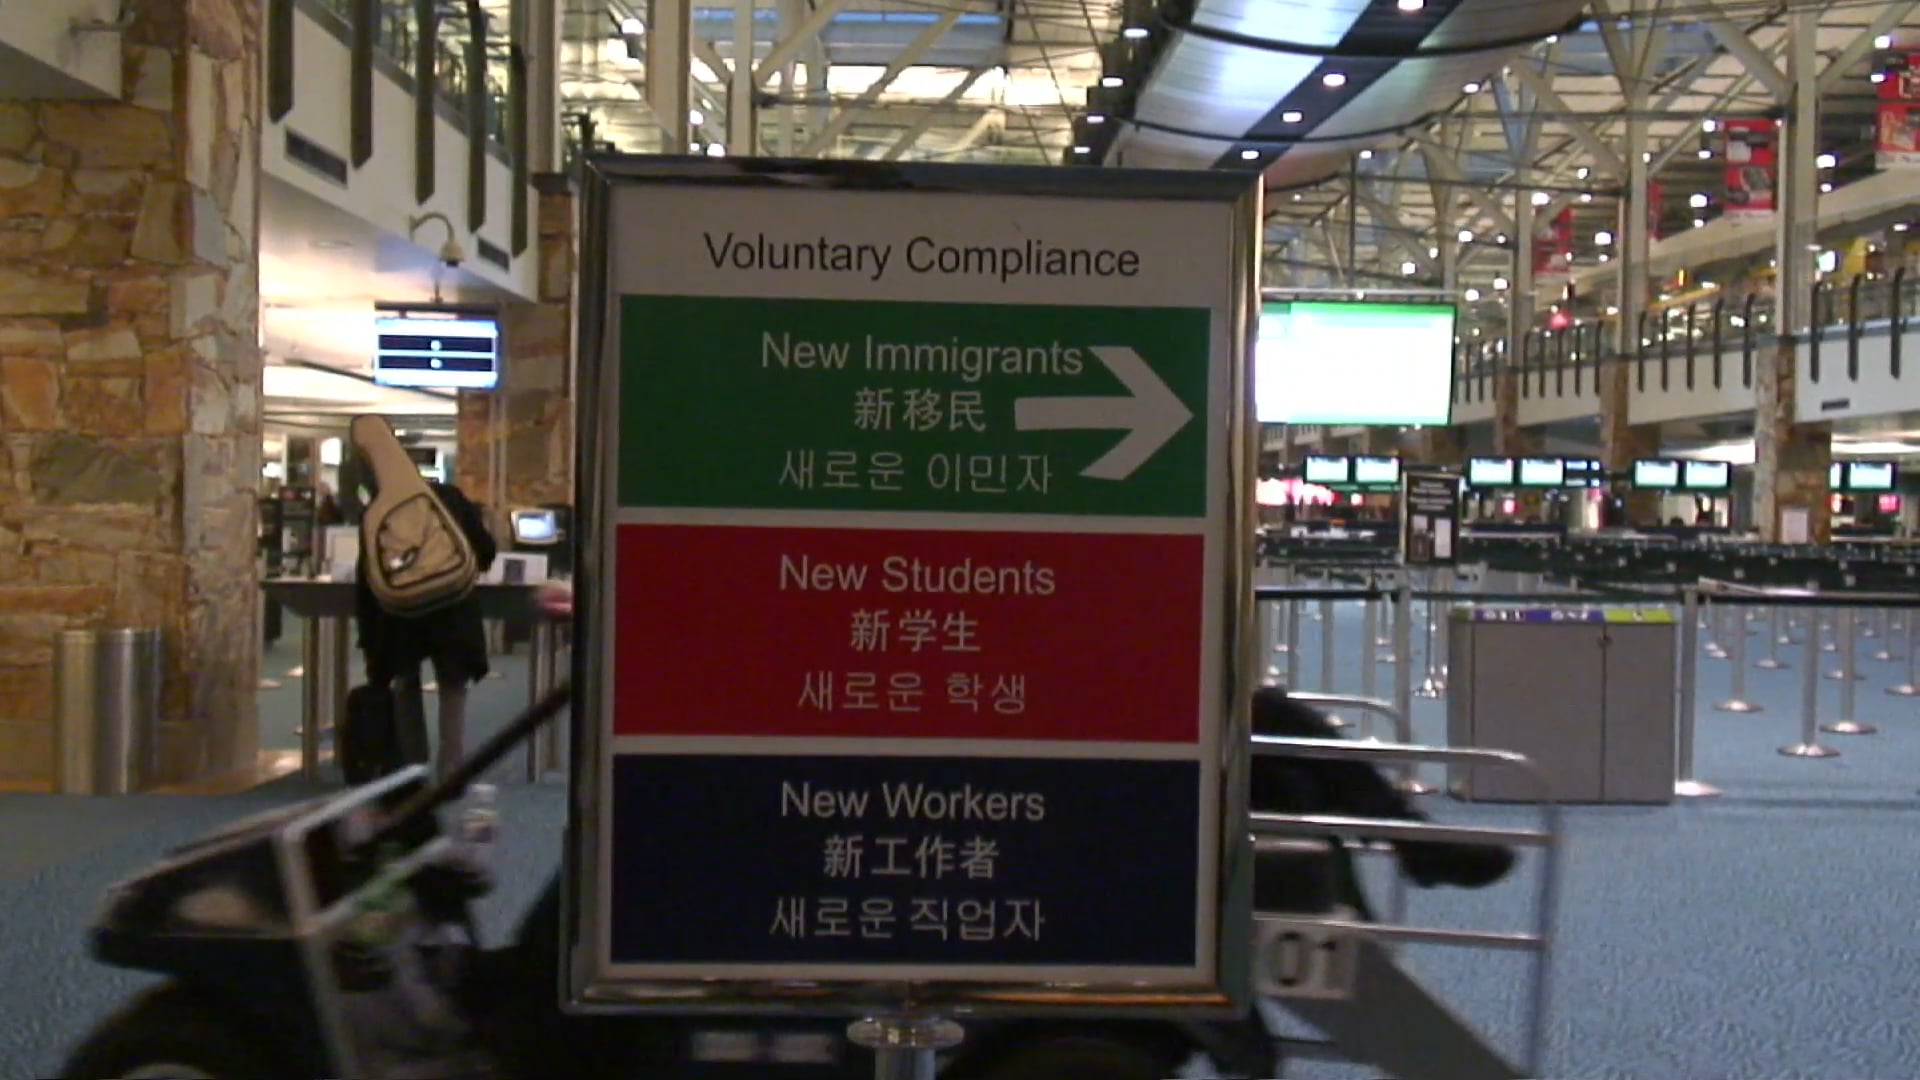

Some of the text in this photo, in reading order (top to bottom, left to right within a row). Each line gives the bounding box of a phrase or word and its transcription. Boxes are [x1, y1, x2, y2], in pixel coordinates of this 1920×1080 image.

[704, 232, 1139, 283] Voluntary Compliance
[762, 332, 1084, 382] New Immigrants
[854, 387, 986, 432] 新移民
[779, 449, 1053, 495] 새로운 이민자
[781, 554, 1056, 595] New Students
[851, 608, 981, 653] 新学生
[799, 671, 1025, 715] 새로운 학생
[782, 781, 1045, 821] New Workers
[824, 835, 1000, 880] 新工作者
